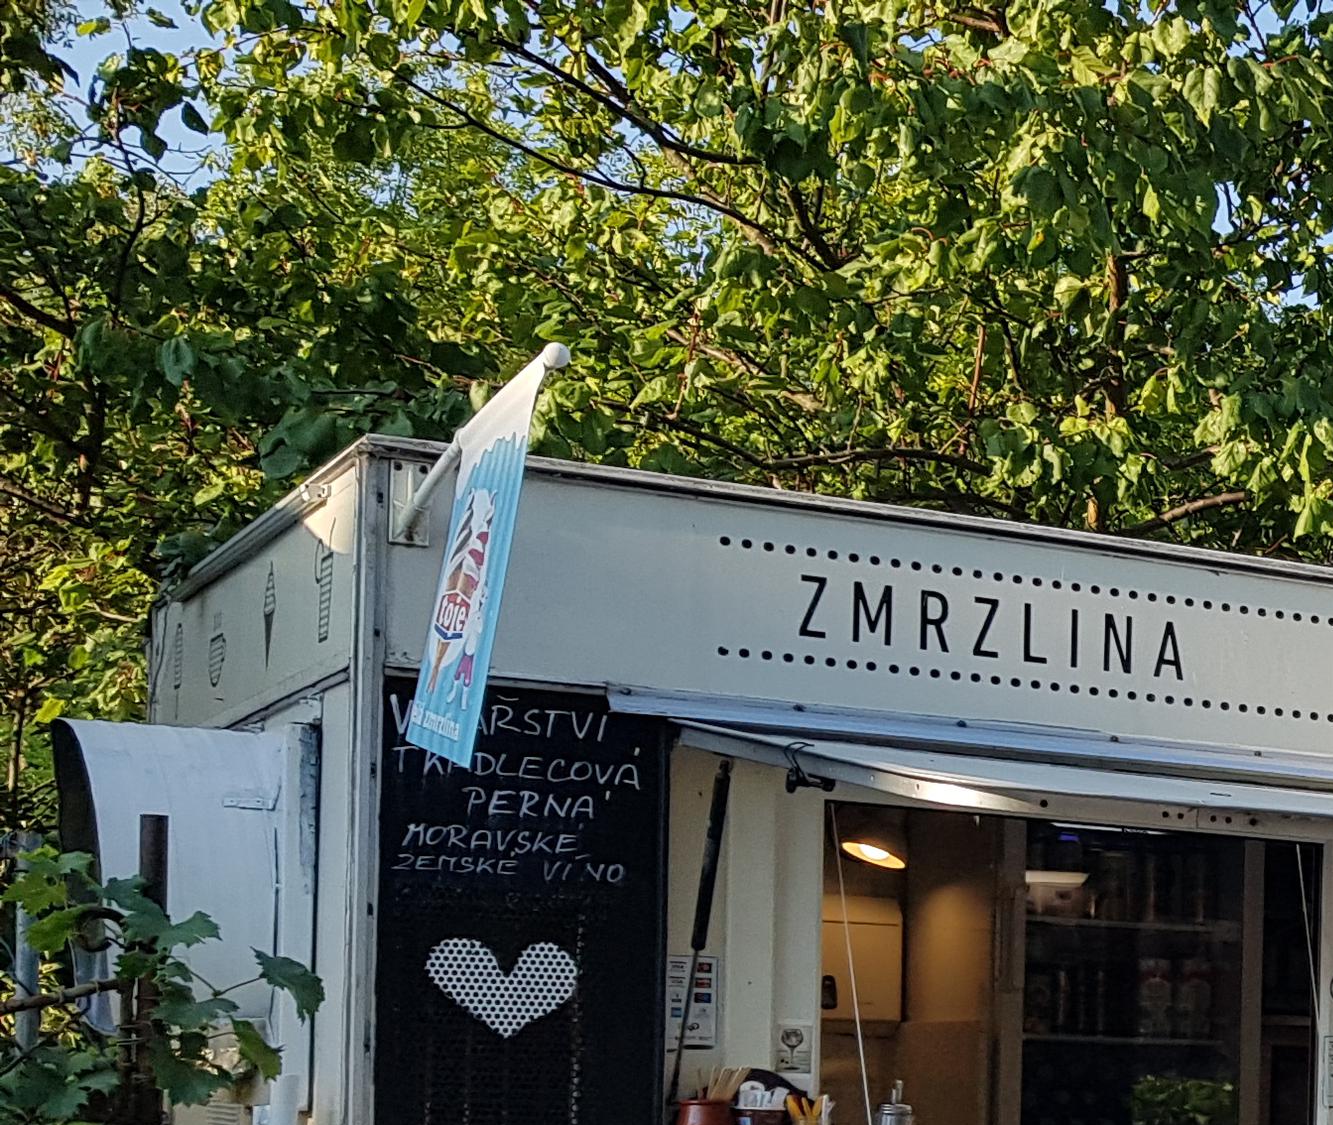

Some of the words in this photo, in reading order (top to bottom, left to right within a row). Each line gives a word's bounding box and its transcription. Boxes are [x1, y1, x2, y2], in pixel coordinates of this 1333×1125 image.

[799, 574, 1183, 681] ZMRZLINA
[462, 786, 612, 820] PERNÁ
[401, 822, 585, 855] MORAVSKÉ
[391, 849, 520, 876] ZEMSKÉ
[543, 852, 626, 882] VÍNO
